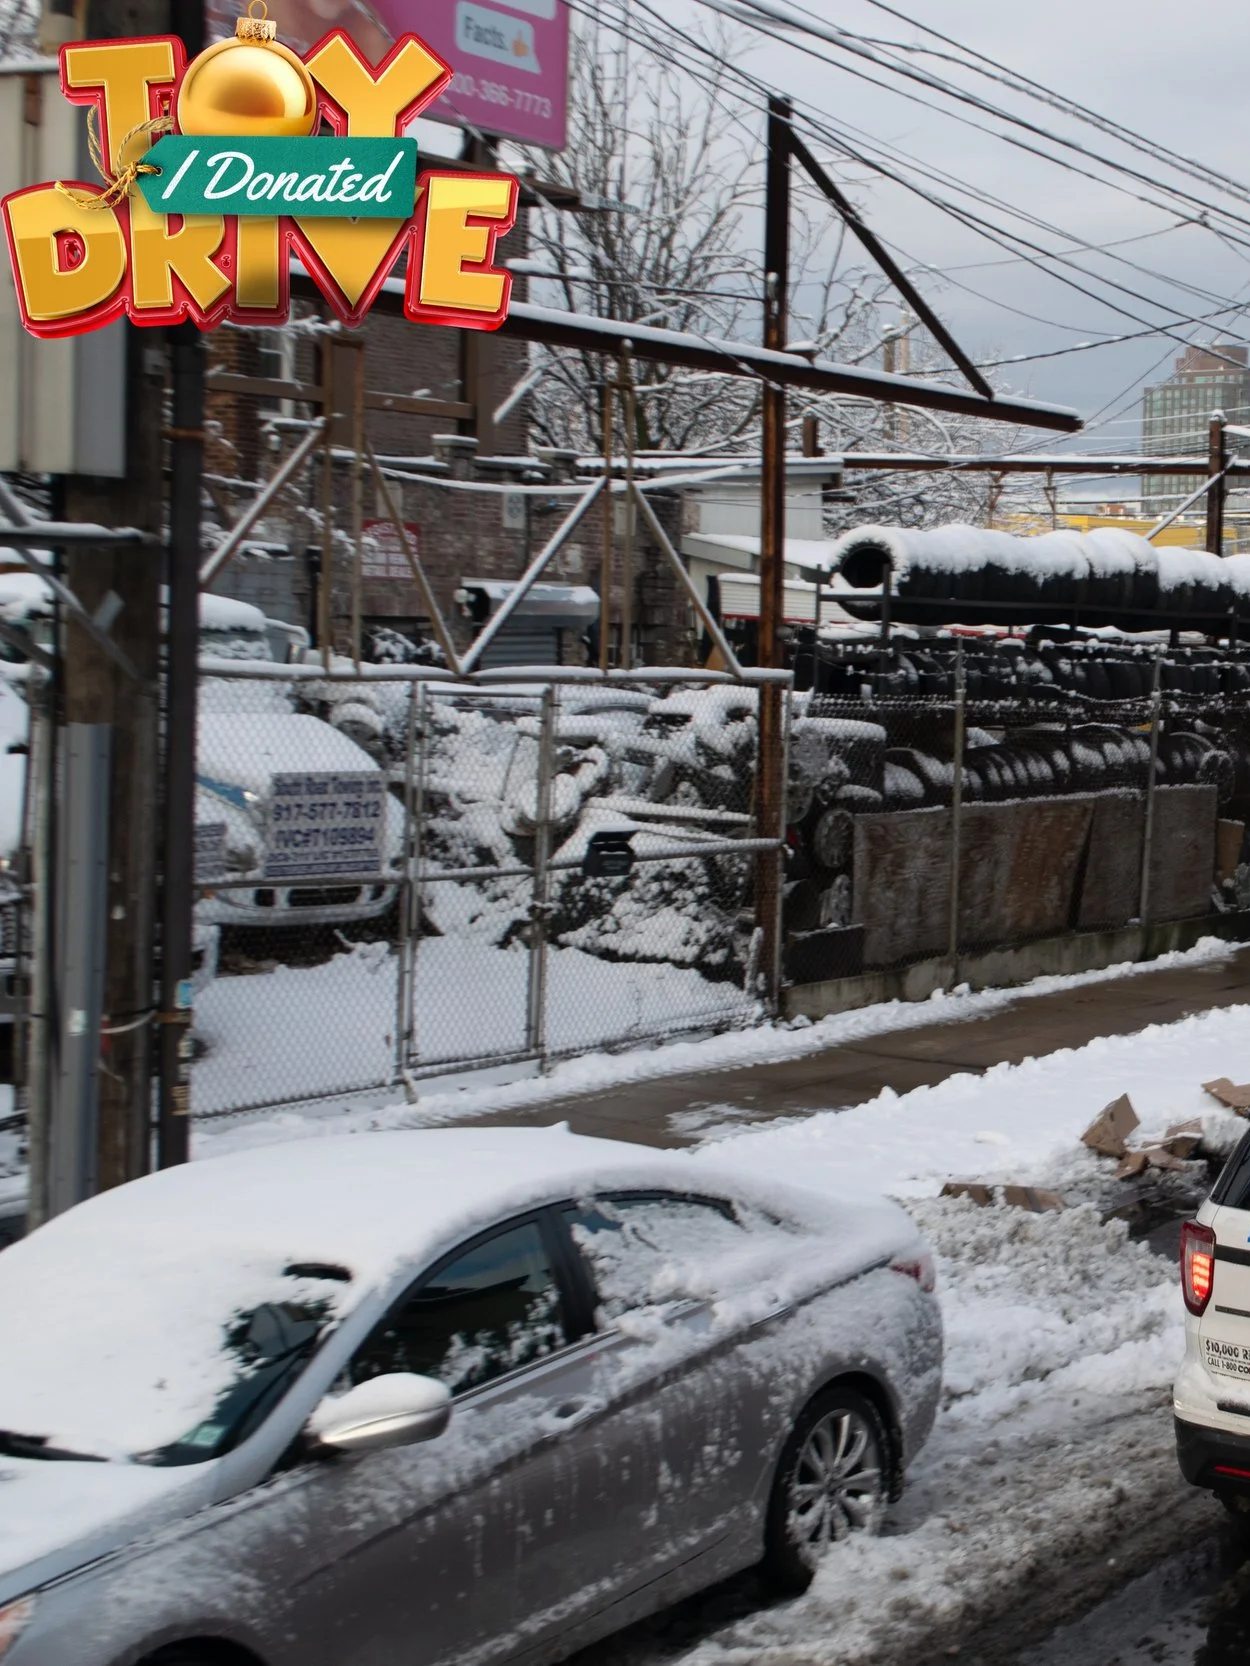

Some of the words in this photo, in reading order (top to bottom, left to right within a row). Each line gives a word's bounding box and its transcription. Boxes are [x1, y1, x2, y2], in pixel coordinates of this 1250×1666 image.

[1205, 1339, 1240, 1359] $10,000
[1207, 1356, 1220, 1368] CALL
[1221, 1359, 1237, 1372] 1-800
